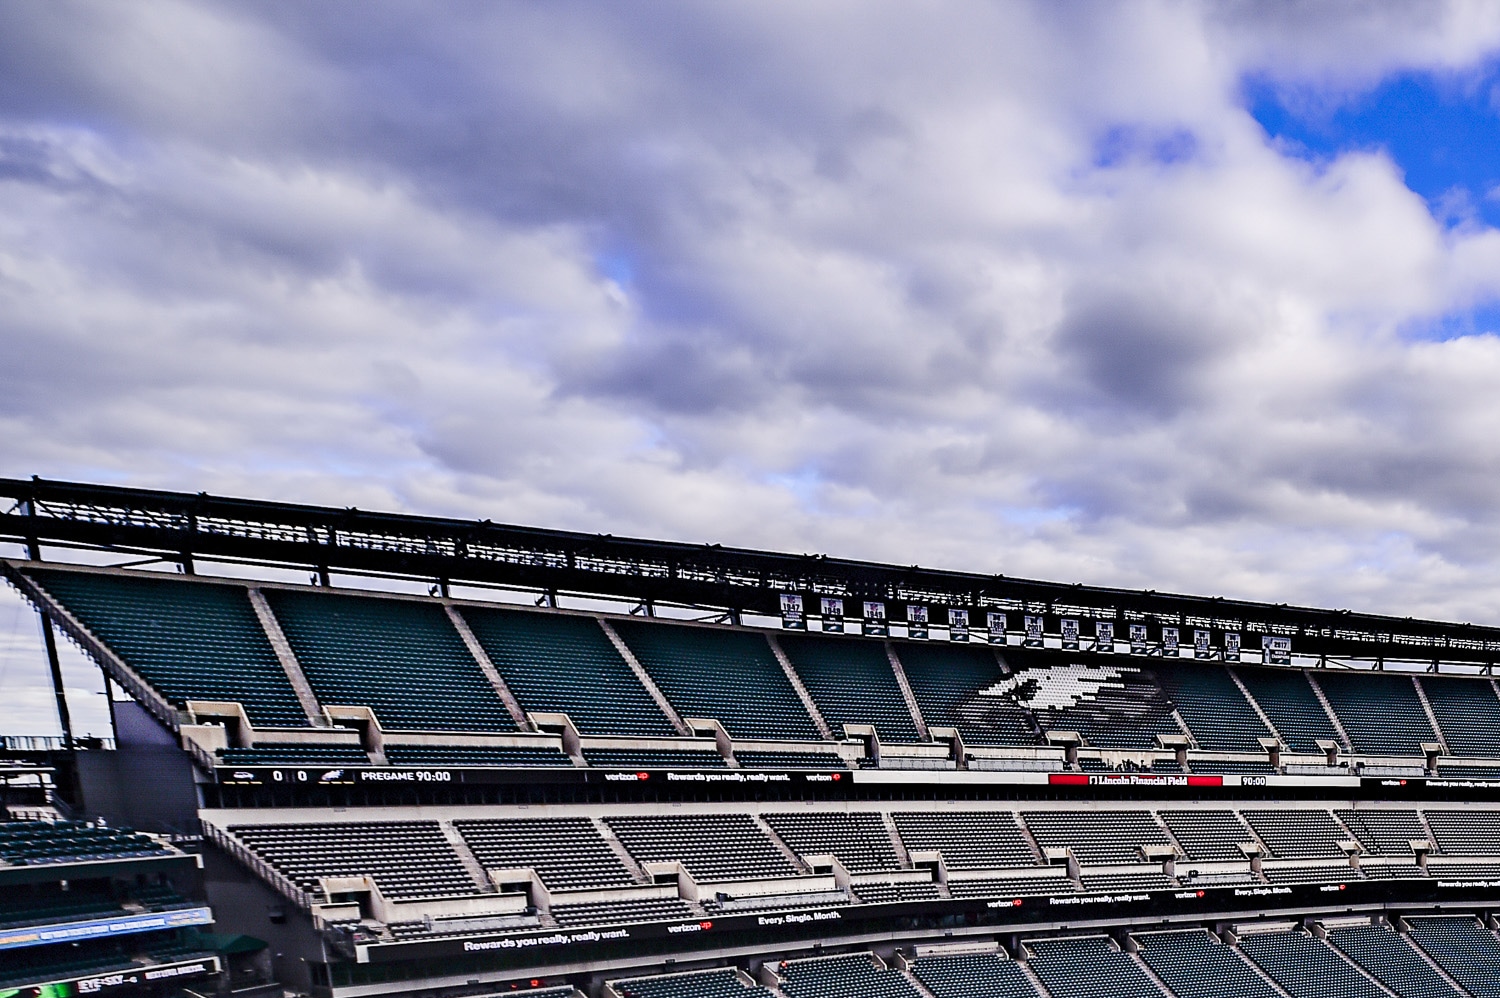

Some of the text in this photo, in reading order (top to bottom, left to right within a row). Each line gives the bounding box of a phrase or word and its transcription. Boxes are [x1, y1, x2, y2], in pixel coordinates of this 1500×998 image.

[783, 602, 800, 611] 1947
[273, 771, 451, 781] 0 0 PREGAME 90:00
[667, 772, 791, 782] Rewards you really, really want.
[1099, 776, 1188, 786] Lincoln Financial Field
[1243, 777, 1266, 786] 90:00
[1049, 897, 1080, 905] Rewards
[1080, 897, 1094, 905] you
[758, 910, 841, 926] Every. Single. Month.
[464, 929, 630, 951] Rewards you really, really want.
